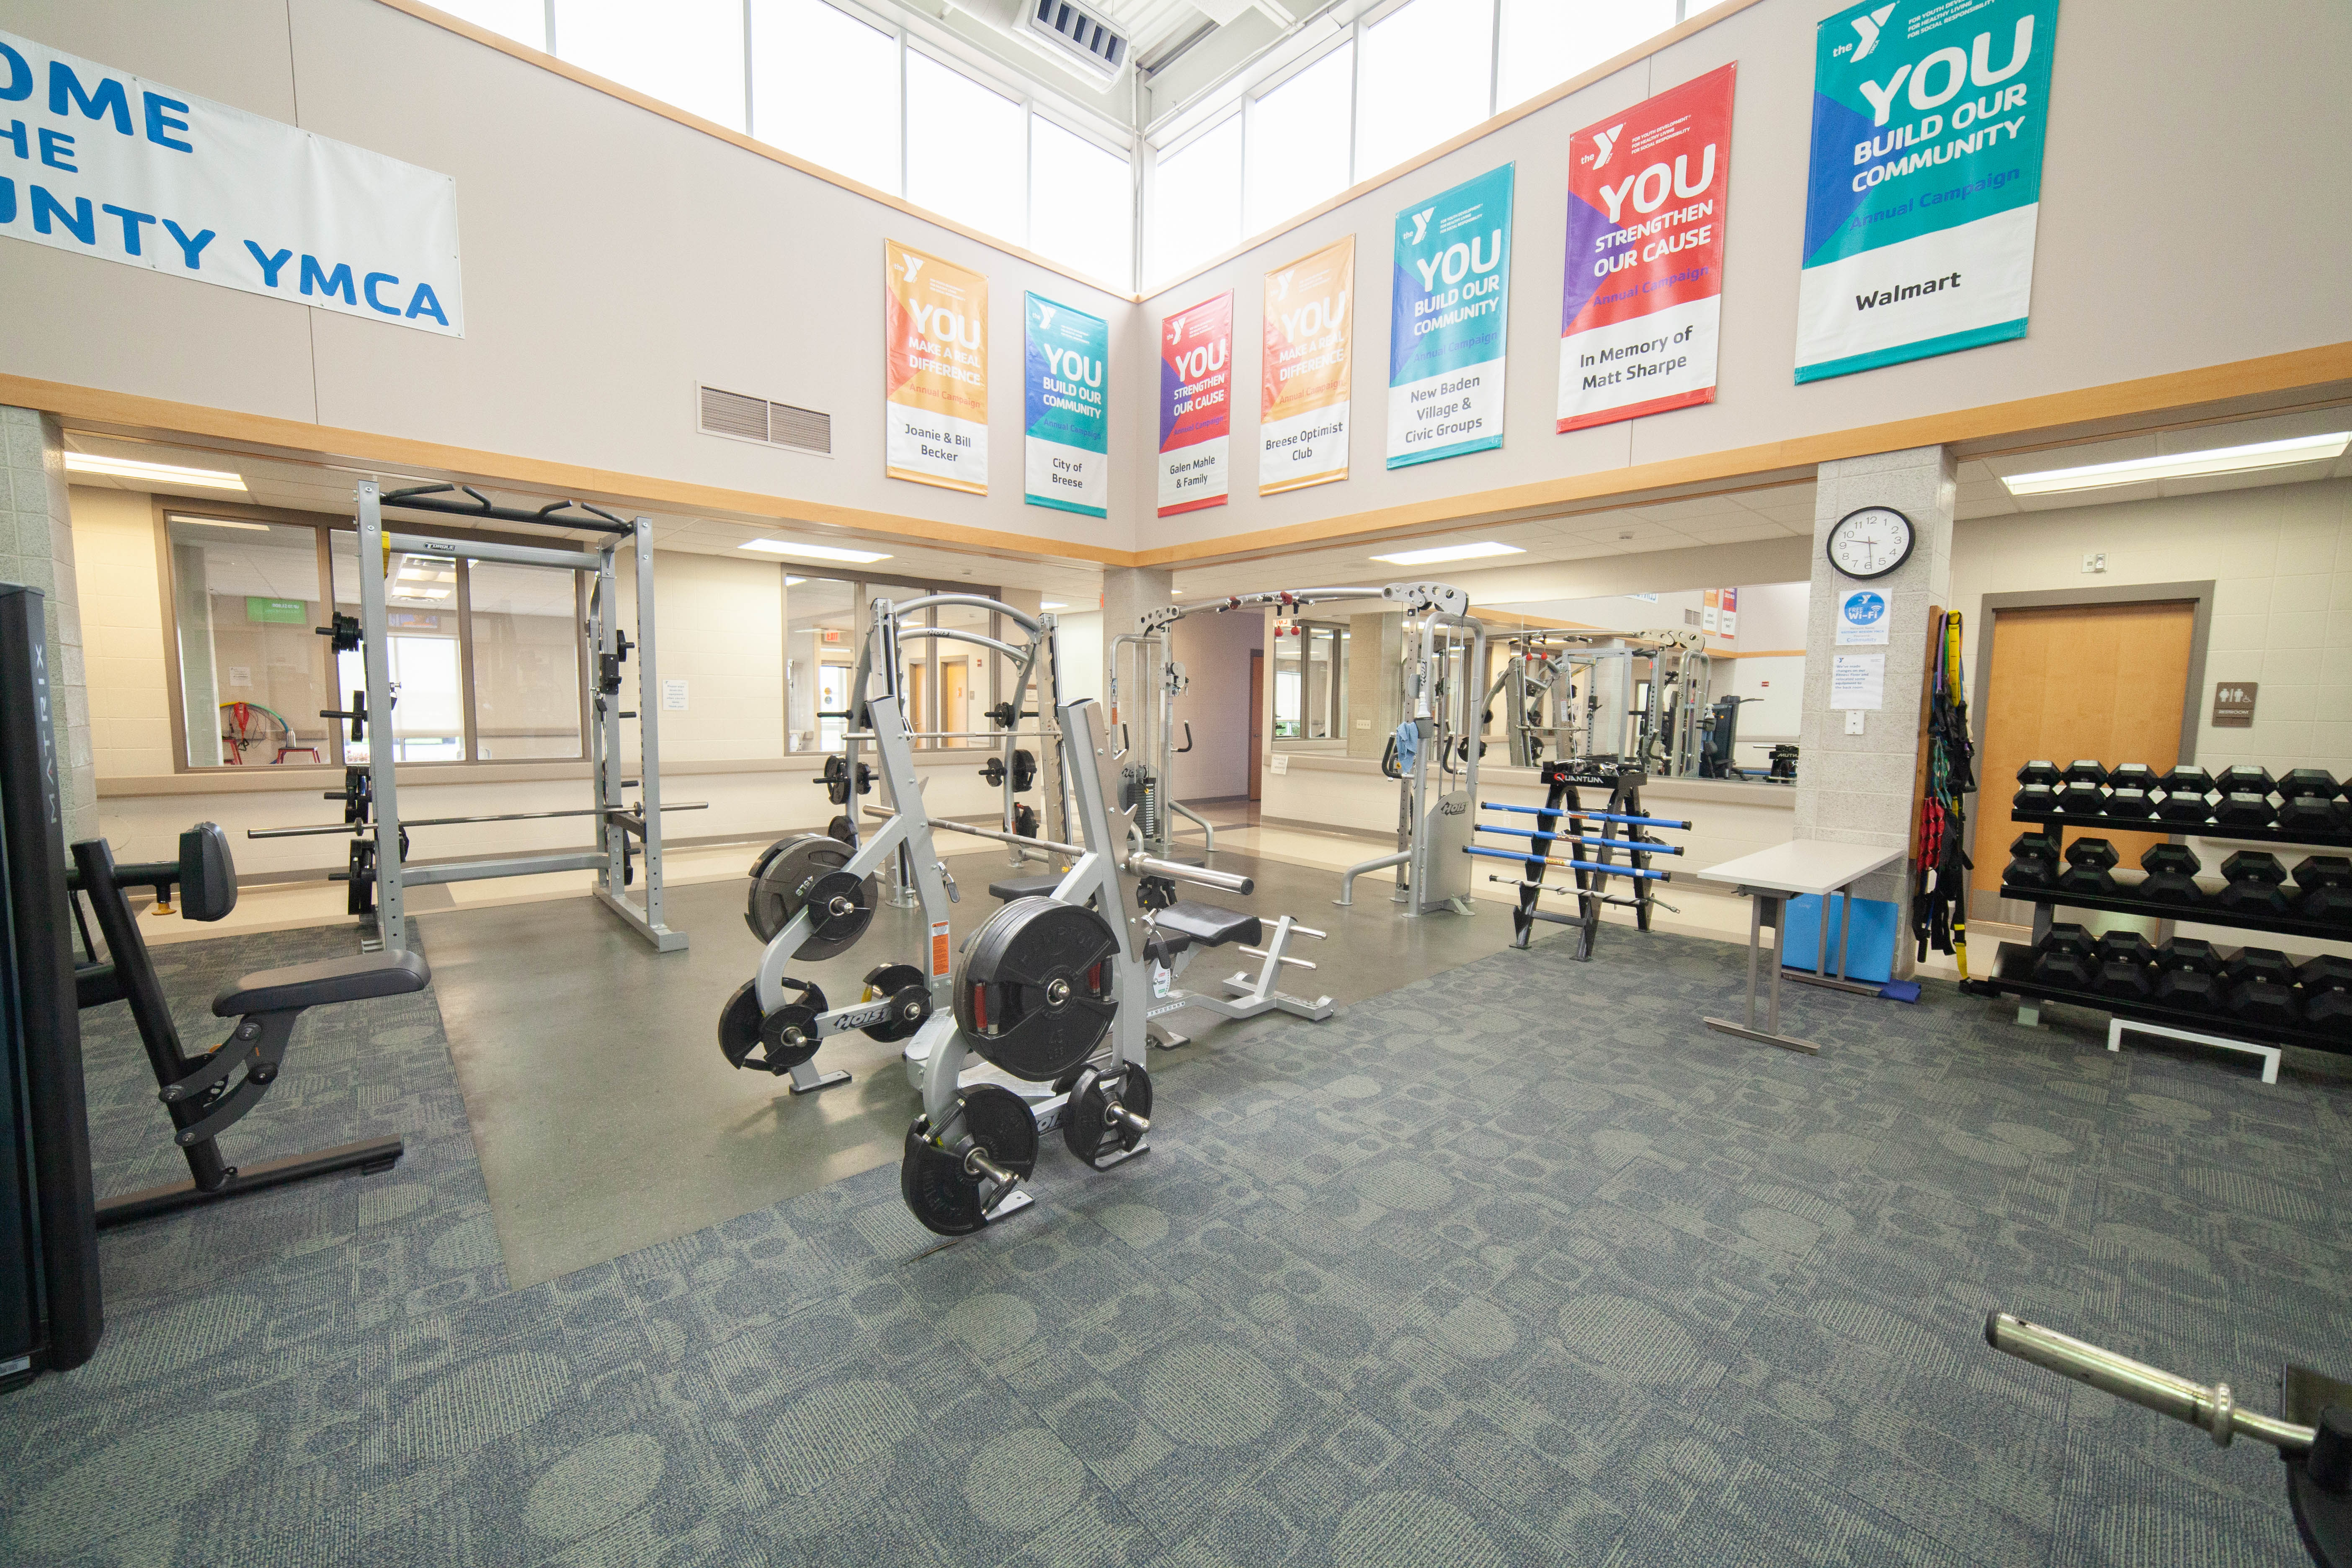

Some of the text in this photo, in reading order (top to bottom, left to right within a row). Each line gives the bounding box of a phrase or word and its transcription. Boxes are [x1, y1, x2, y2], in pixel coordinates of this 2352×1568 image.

[1908, 5, 1944, 25] FOR YOUTH
[1908, 1, 1972, 32] FOR HEALTHY LIVING
[1921, 21, 1942, 33] SOCIAL
[1944, 0, 1995, 24] RESPONSIBILITY
[1833, 43, 1852, 57] the
[1859, 14, 2034, 127] YOU
[1640, 134, 1659, 145] HEALTHY
[1660, 128, 1675, 137] LIVING
[1641, 130, 1656, 139] YOUTH
[1854, 83, 2027, 166] BUILD OUR
[1640, 142, 1655, 151] SOCIAL
[1656, 127, 1690, 144] RESPONSIBILITY
[1581, 154, 1594, 164] the
[1852, 116, 2025, 192] COMMUNITY
[1599, 143, 1716, 224] YOU
[1849, 168, 2020, 231] Annual Campaign
[1403, 231, 1413, 240] the
[1595, 200, 1713, 253] STRENGTHEN
[1417, 229, 1501, 292] YOU
[1594, 224, 1712, 278] OUR CAUSE
[894, 263, 904, 271] the
[243, 239, 449, 327] YMCA
[1415, 274, 1499, 317] BUILD OUR
[1593, 266, 1709, 307] Annual Campaign
[1856, 271, 1961, 311] Walmart
[910, 298, 980, 350] YOU
[1282, 291, 1346, 343] YOU
[1414, 297, 1499, 336] COMMUNITY
[909, 337, 980, 368] MAKE A REAL
[1176, 338, 1226, 382] YOU
[1279, 333, 1344, 363] MAKE A REAL
[1413, 331, 1497, 363] Annual Campaign
[1581, 325, 1694, 368] In Memory of
[909, 355, 981, 386] DIFFERENCE
[1044, 343, 1101, 387] YOU
[1280, 348, 1344, 381] DIFFERENCE
[1582, 355, 1687, 390] Matt Sharpe
[910, 383, 980, 410] Annual Campaign
[1044, 376, 1101, 405] BUILD OUR
[1174, 373, 1225, 400] STRENGTHEN
[1280, 380, 1343, 404] Annual Campaign
[1411, 376, 1480, 403] New Baden
[1044, 394, 1101, 419] COMMUNITY
[1174, 389, 1224, 417] OUR CAUSE
[1417, 398, 1471, 421] Village &
[905, 423, 971, 448] Joanie & Bill
[1044, 418, 1101, 440] Annual Campaign
[1174, 415, 1223, 436] Annual Campaign
[1266, 422, 1343, 450] Breese Optimist
[1406, 418, 1482, 444] Civic Groups
[921, 444, 958, 462] Becker
[1053, 458, 1082, 473] City of
[1170, 456, 1215, 475] Galen Mahle
[1293, 447, 1312, 460] Club
[1052, 473, 1083, 489] Breese
[1176, 474, 1207, 488] & Family
[35, 643, 57, 824] MATRIX
[1554, 773, 1604, 784] QUANTUM
[1441, 801, 1469, 815] HOIST
[835, 1007, 890, 1030] HOIST
